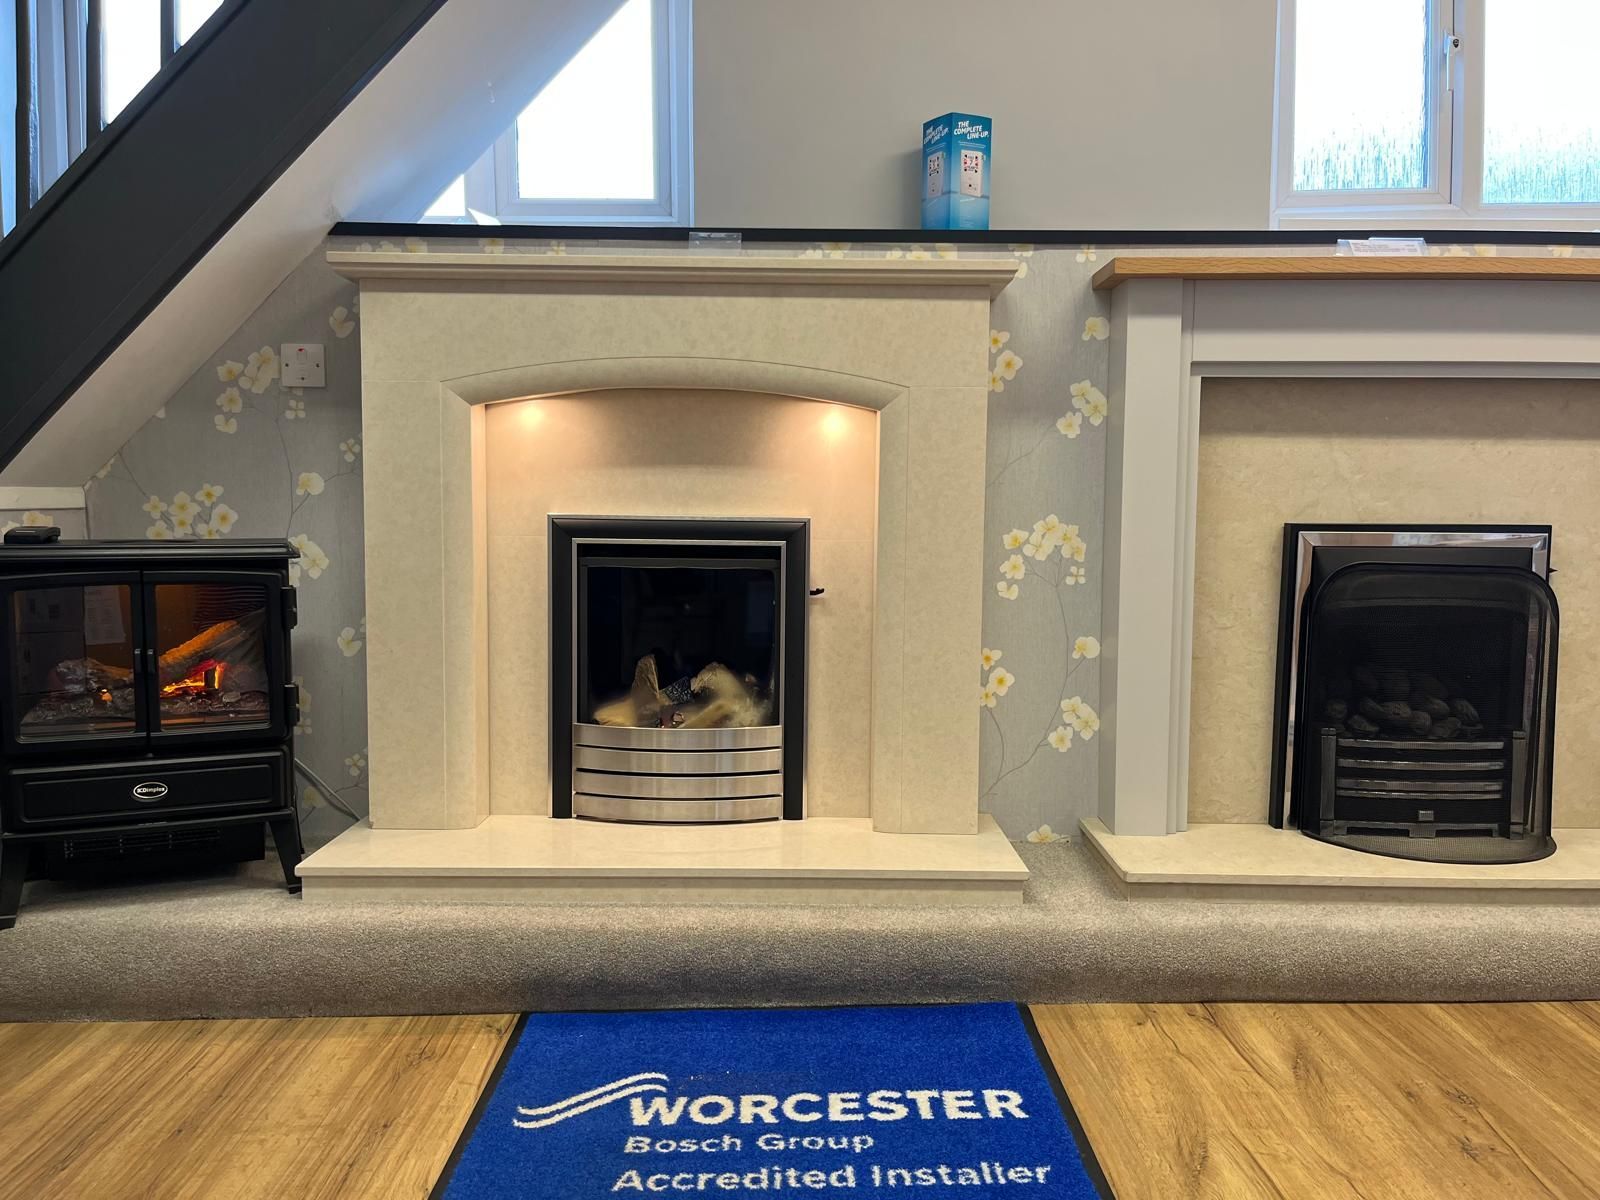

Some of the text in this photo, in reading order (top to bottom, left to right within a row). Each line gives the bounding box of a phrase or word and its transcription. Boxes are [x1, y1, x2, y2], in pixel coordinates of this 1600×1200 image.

[924, 125, 943, 144] COMPLETE
[954, 126, 982, 135] COMPLETE
[630, 1089, 1028, 1127] WORCESTER
[623, 1133, 875, 1154] Bosch Group
[611, 1163, 1051, 1192] Accredited Installer
